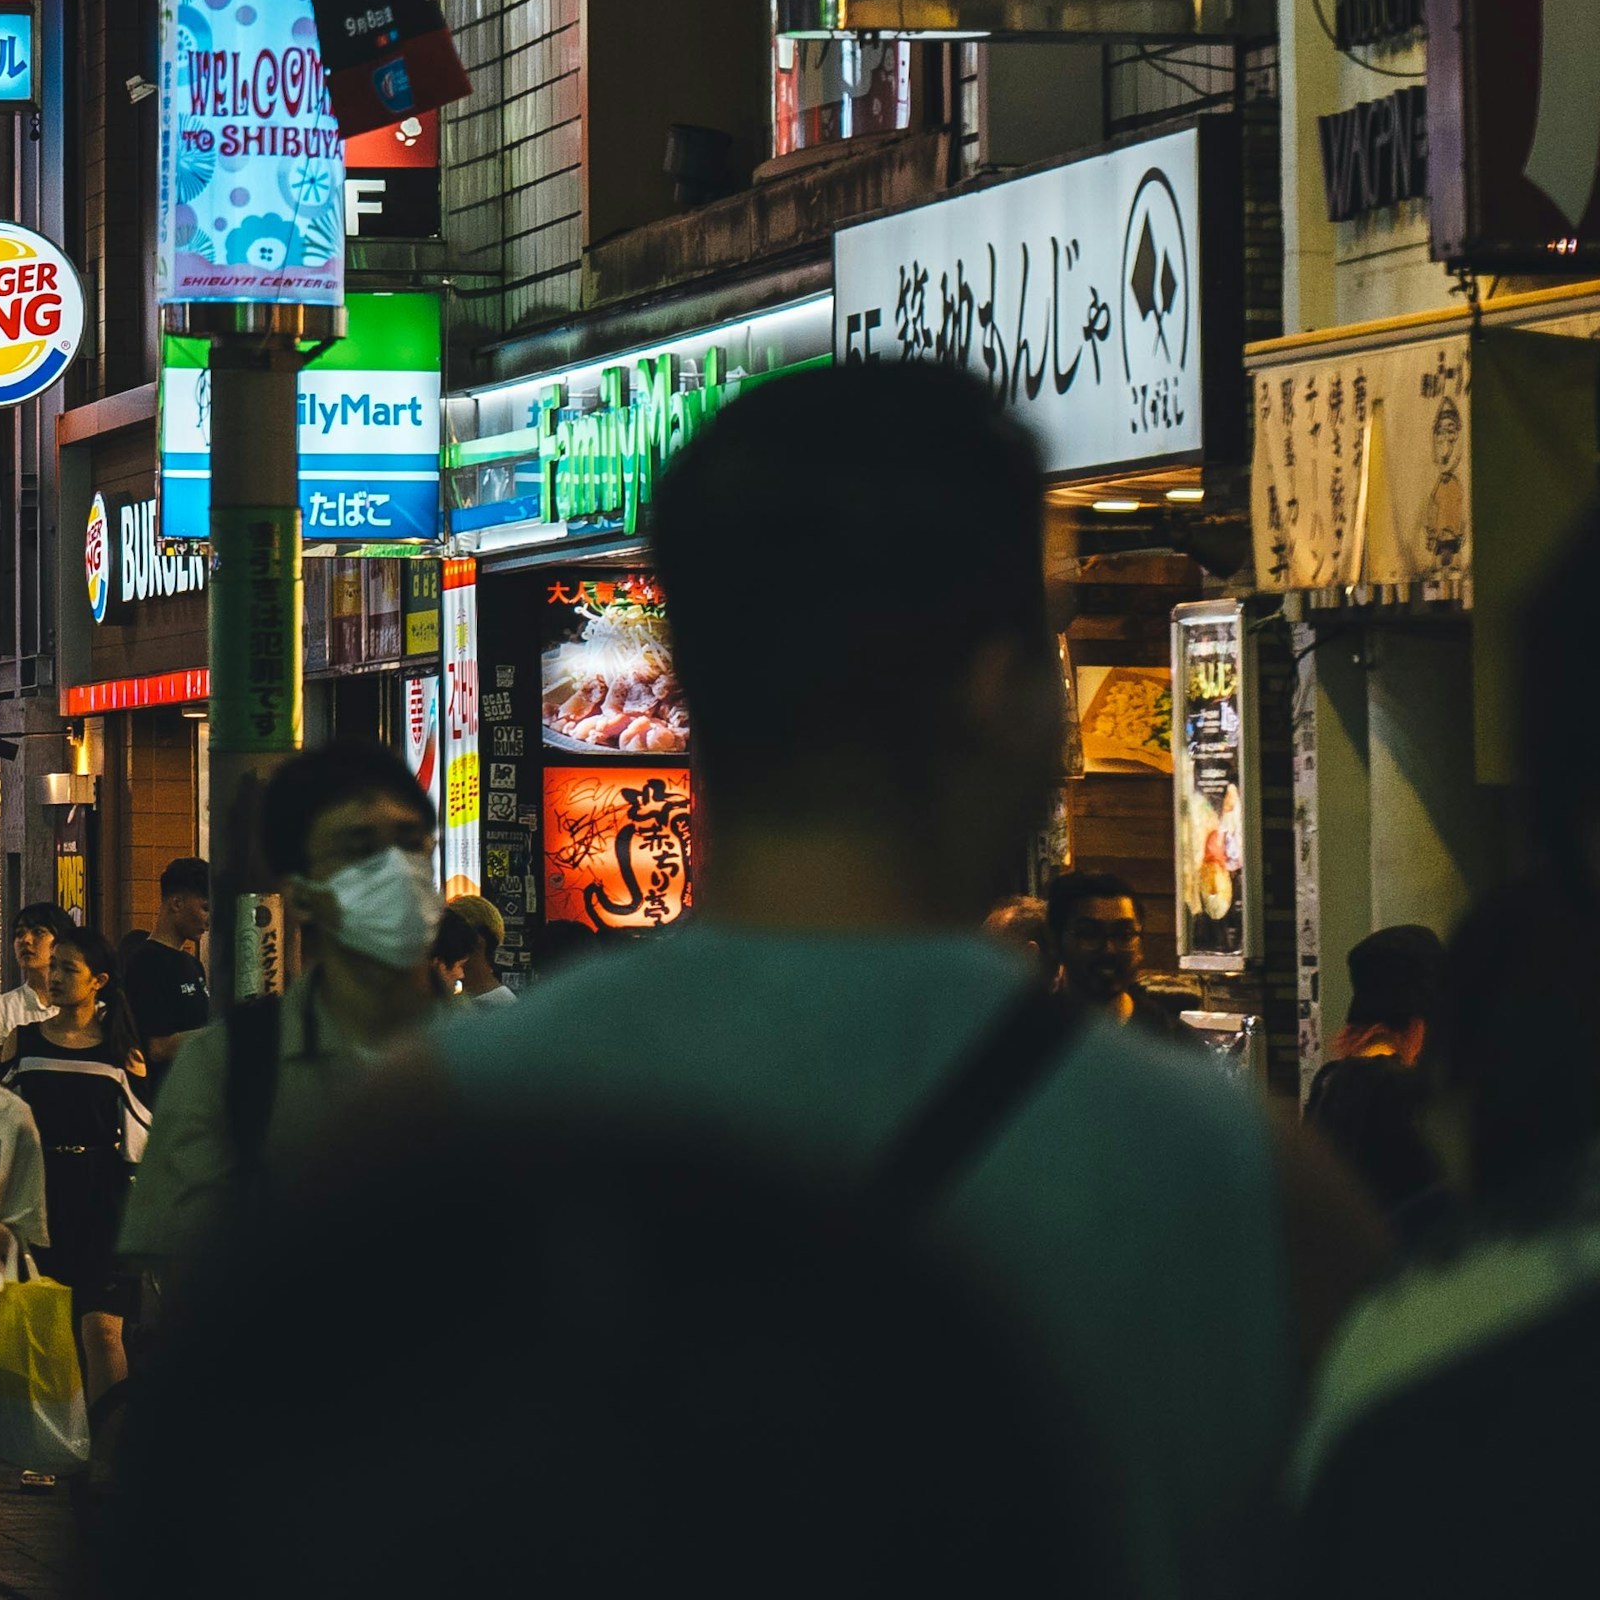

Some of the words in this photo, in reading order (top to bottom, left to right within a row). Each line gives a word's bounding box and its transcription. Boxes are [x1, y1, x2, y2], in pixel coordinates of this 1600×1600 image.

[181, 130, 215, 152] TO
[218, 128, 345, 160] SHIBUYA
[181, 275, 250, 290] SHIBUYA
[308, 490, 392, 528] たばこ
